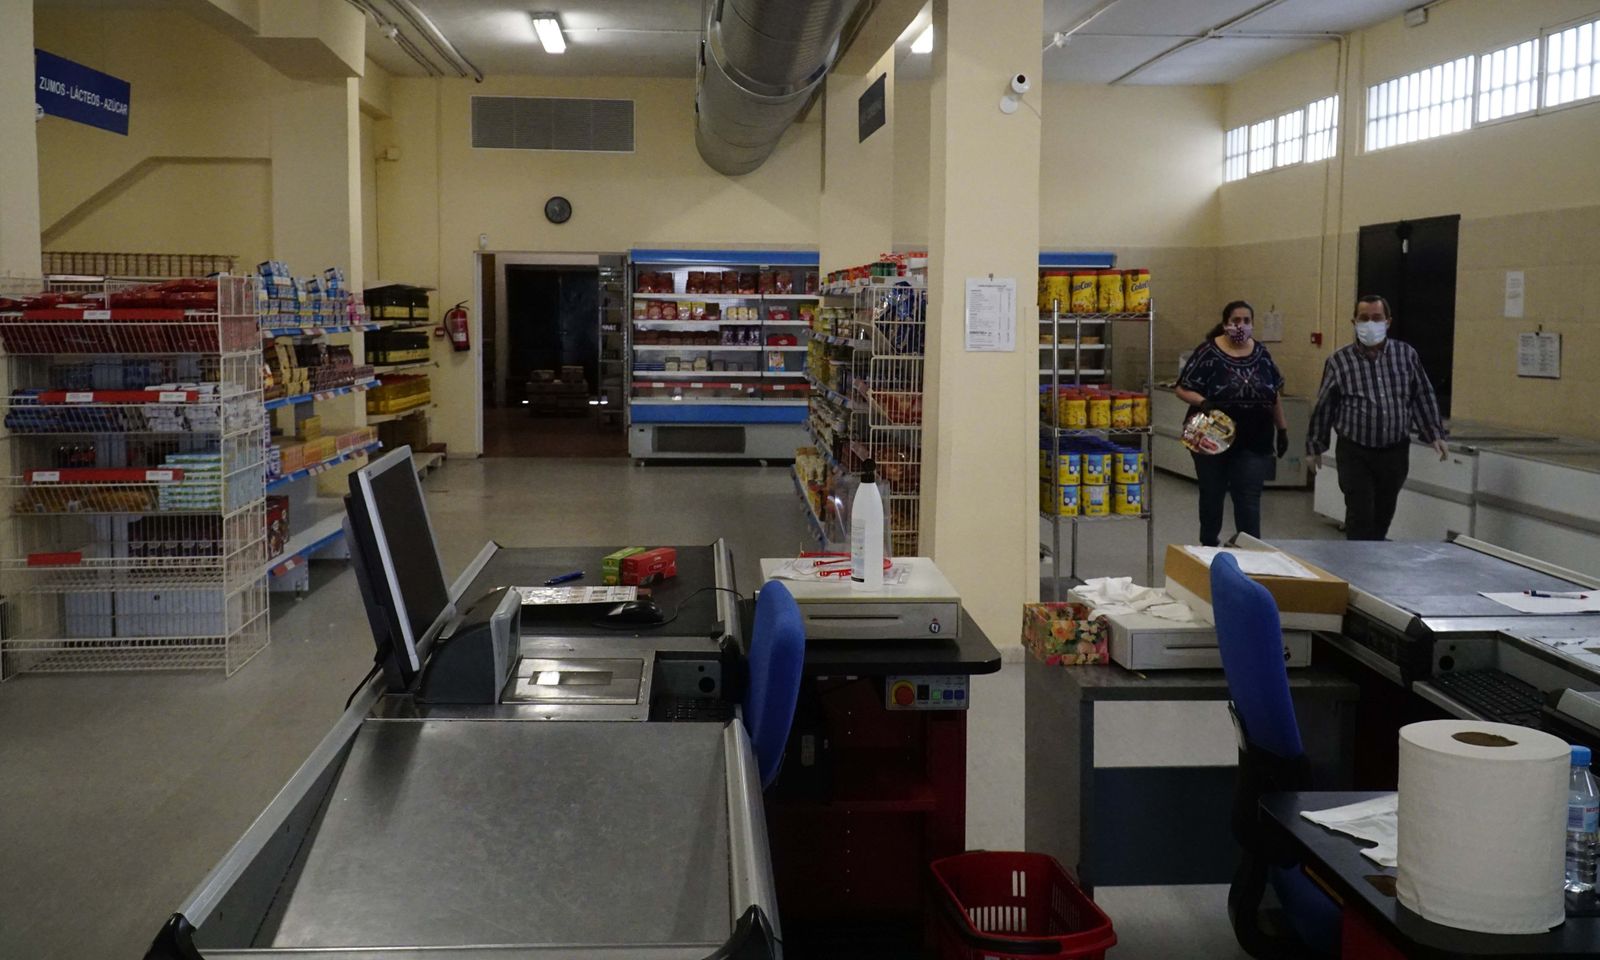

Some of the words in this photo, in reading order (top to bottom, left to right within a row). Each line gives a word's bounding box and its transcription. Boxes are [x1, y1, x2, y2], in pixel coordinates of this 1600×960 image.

[39, 76, 66, 96] ZUMOS
[70, 85, 100, 107] LÁCTEOS
[103, 98, 128, 116] AZÚCAR
